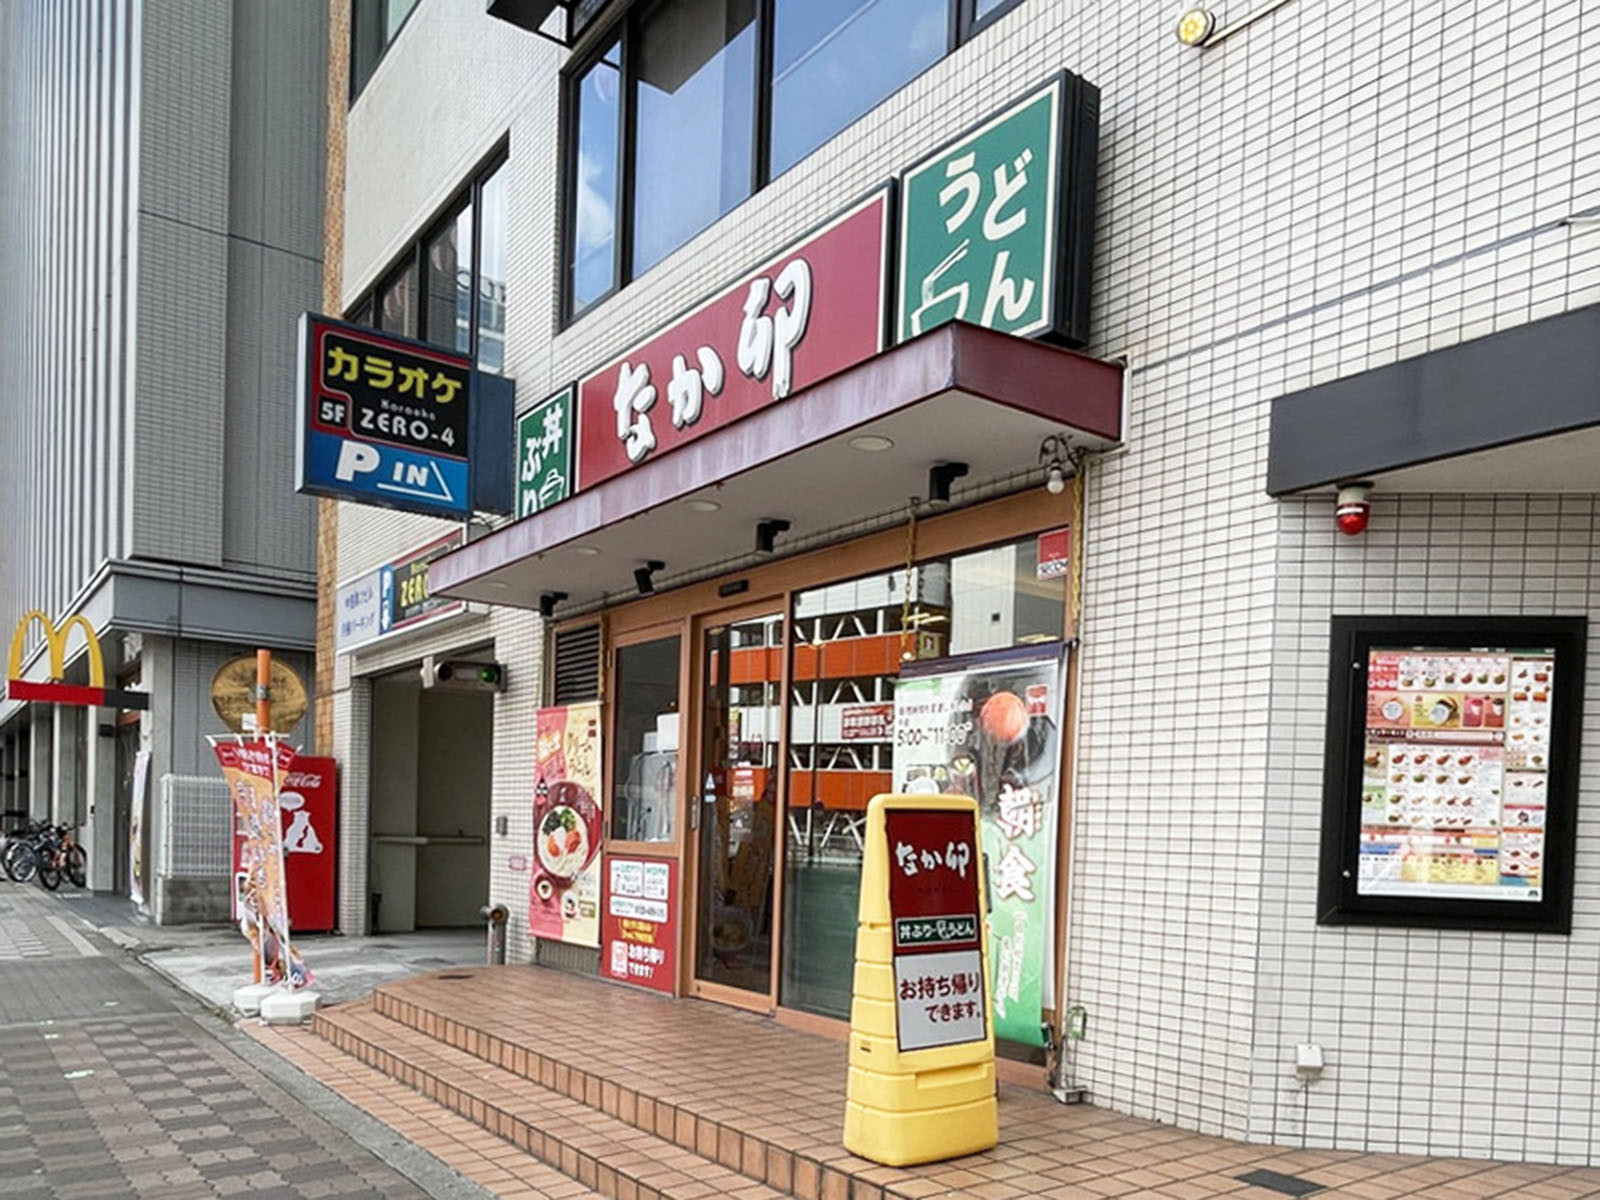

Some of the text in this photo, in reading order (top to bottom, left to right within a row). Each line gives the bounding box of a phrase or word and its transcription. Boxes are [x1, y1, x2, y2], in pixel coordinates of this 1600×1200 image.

[937, 147, 1035, 331] うどん
[327, 346, 462, 403] カラオケ
[613, 257, 816, 463] なか卯
[320, 402, 346, 423] 5F
[360, 408, 455, 447] ZERO-4
[335, 439, 380, 482] P
[392, 461, 429, 488] IN
[895, 841, 970, 878] なか卯
[996, 783, 1041, 901] 朝食
[899, 972, 980, 1001] お持ち帰り
